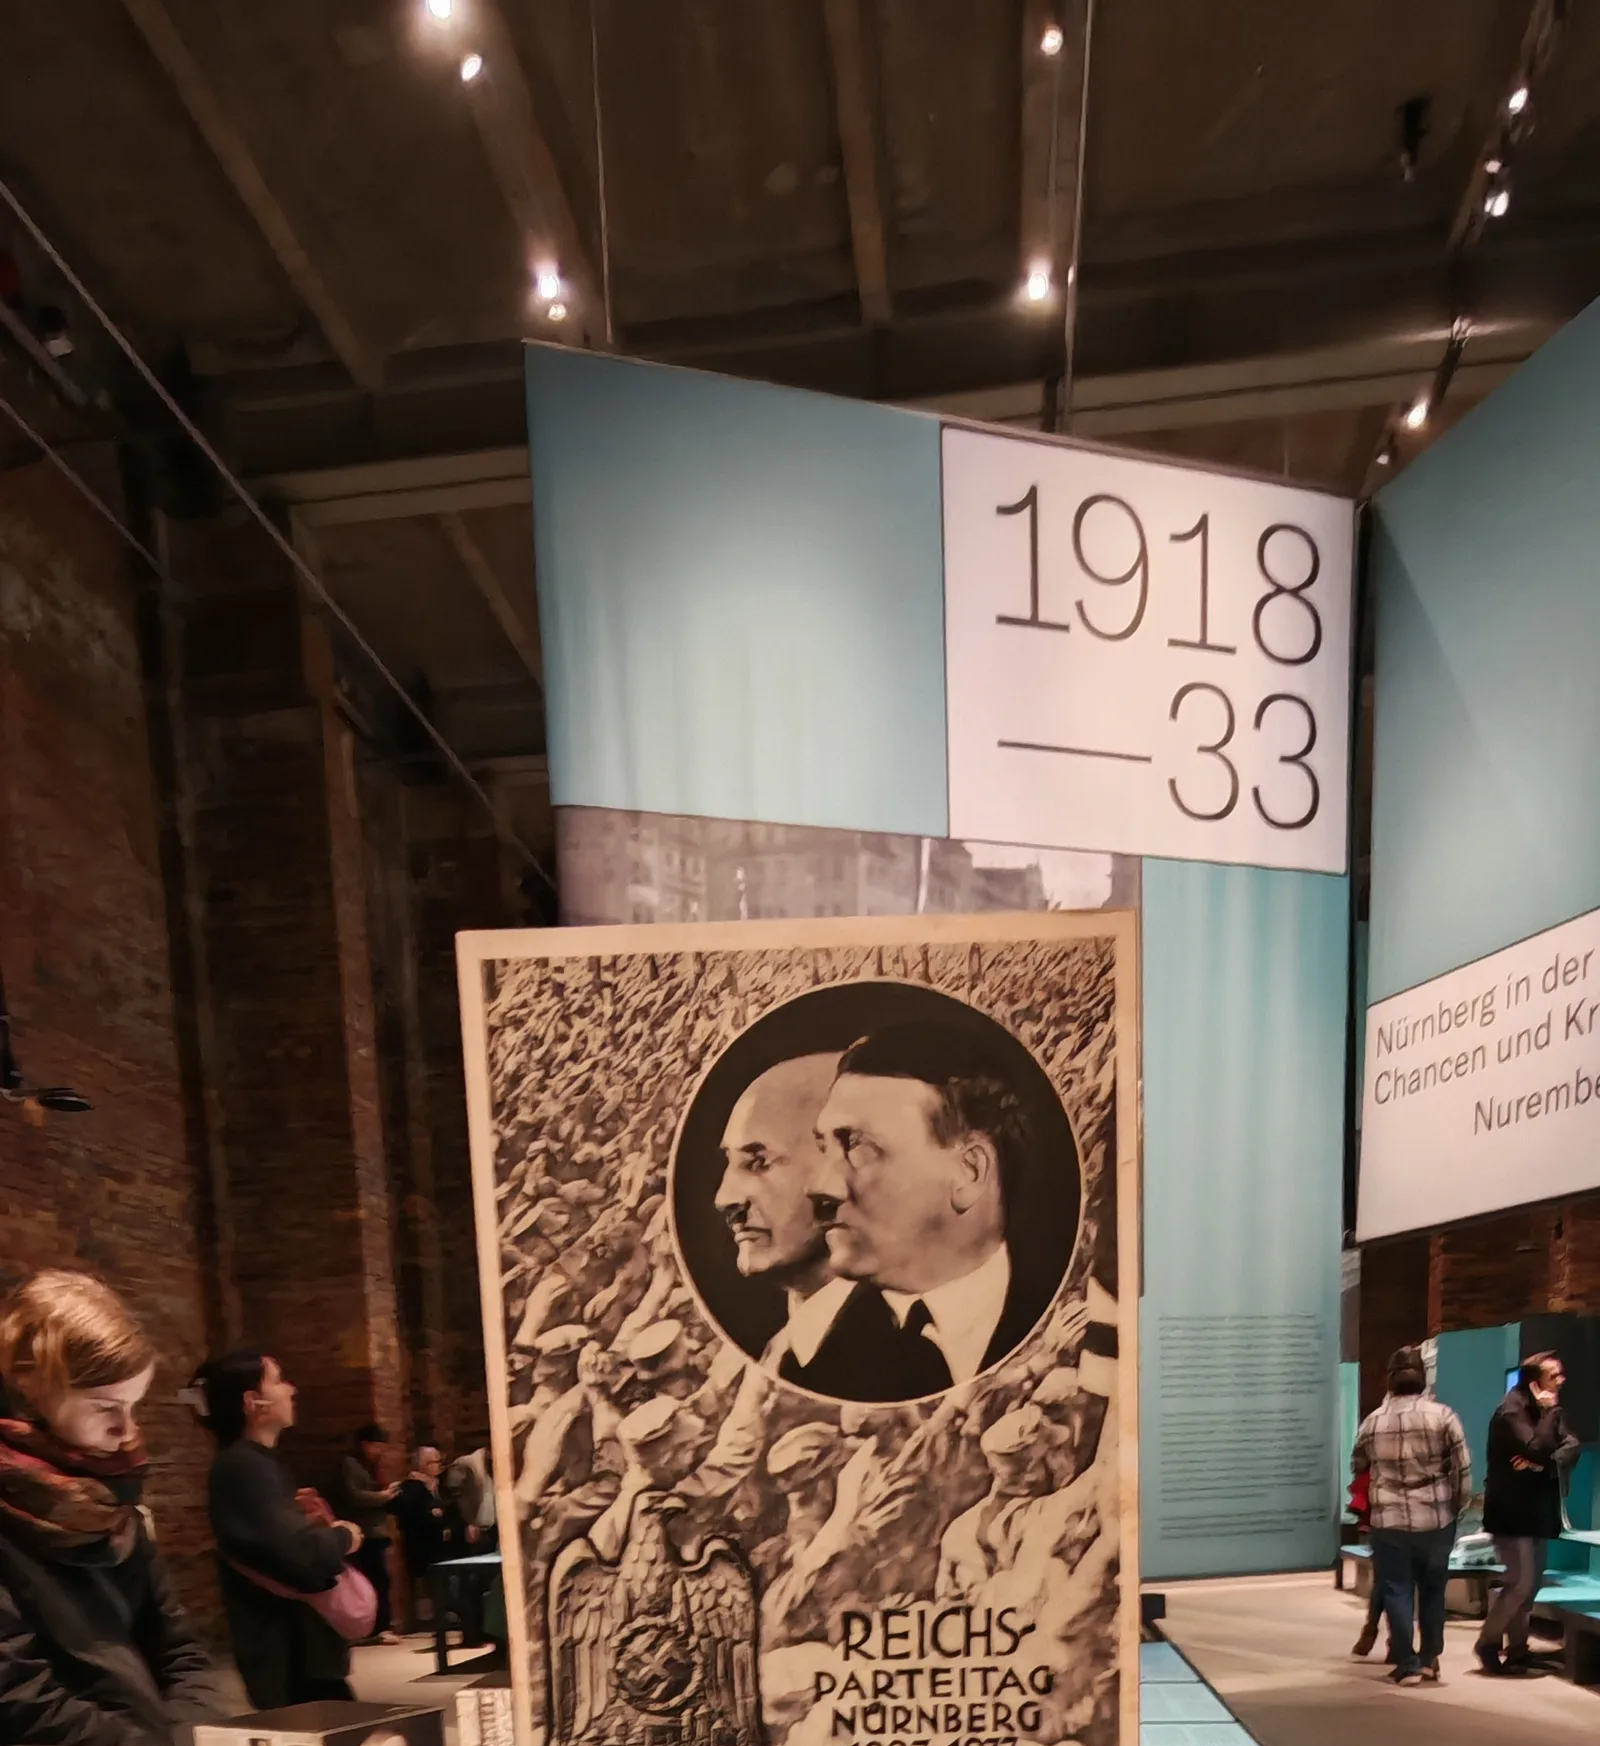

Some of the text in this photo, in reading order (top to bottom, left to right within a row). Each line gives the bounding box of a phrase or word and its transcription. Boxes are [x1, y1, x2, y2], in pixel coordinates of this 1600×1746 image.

[995, 484, 1323, 667] 1918
[1376, 947, 1595, 1059] Nürnberg in der
[1374, 1044, 1486, 1106] Chancen
[1497, 1008, 1552, 1064] und
[842, 1606, 1036, 1662] REICHS-
[814, 1665, 1055, 1702] PARTEITAG
[831, 1700, 1042, 1737] NÜRNBERG
